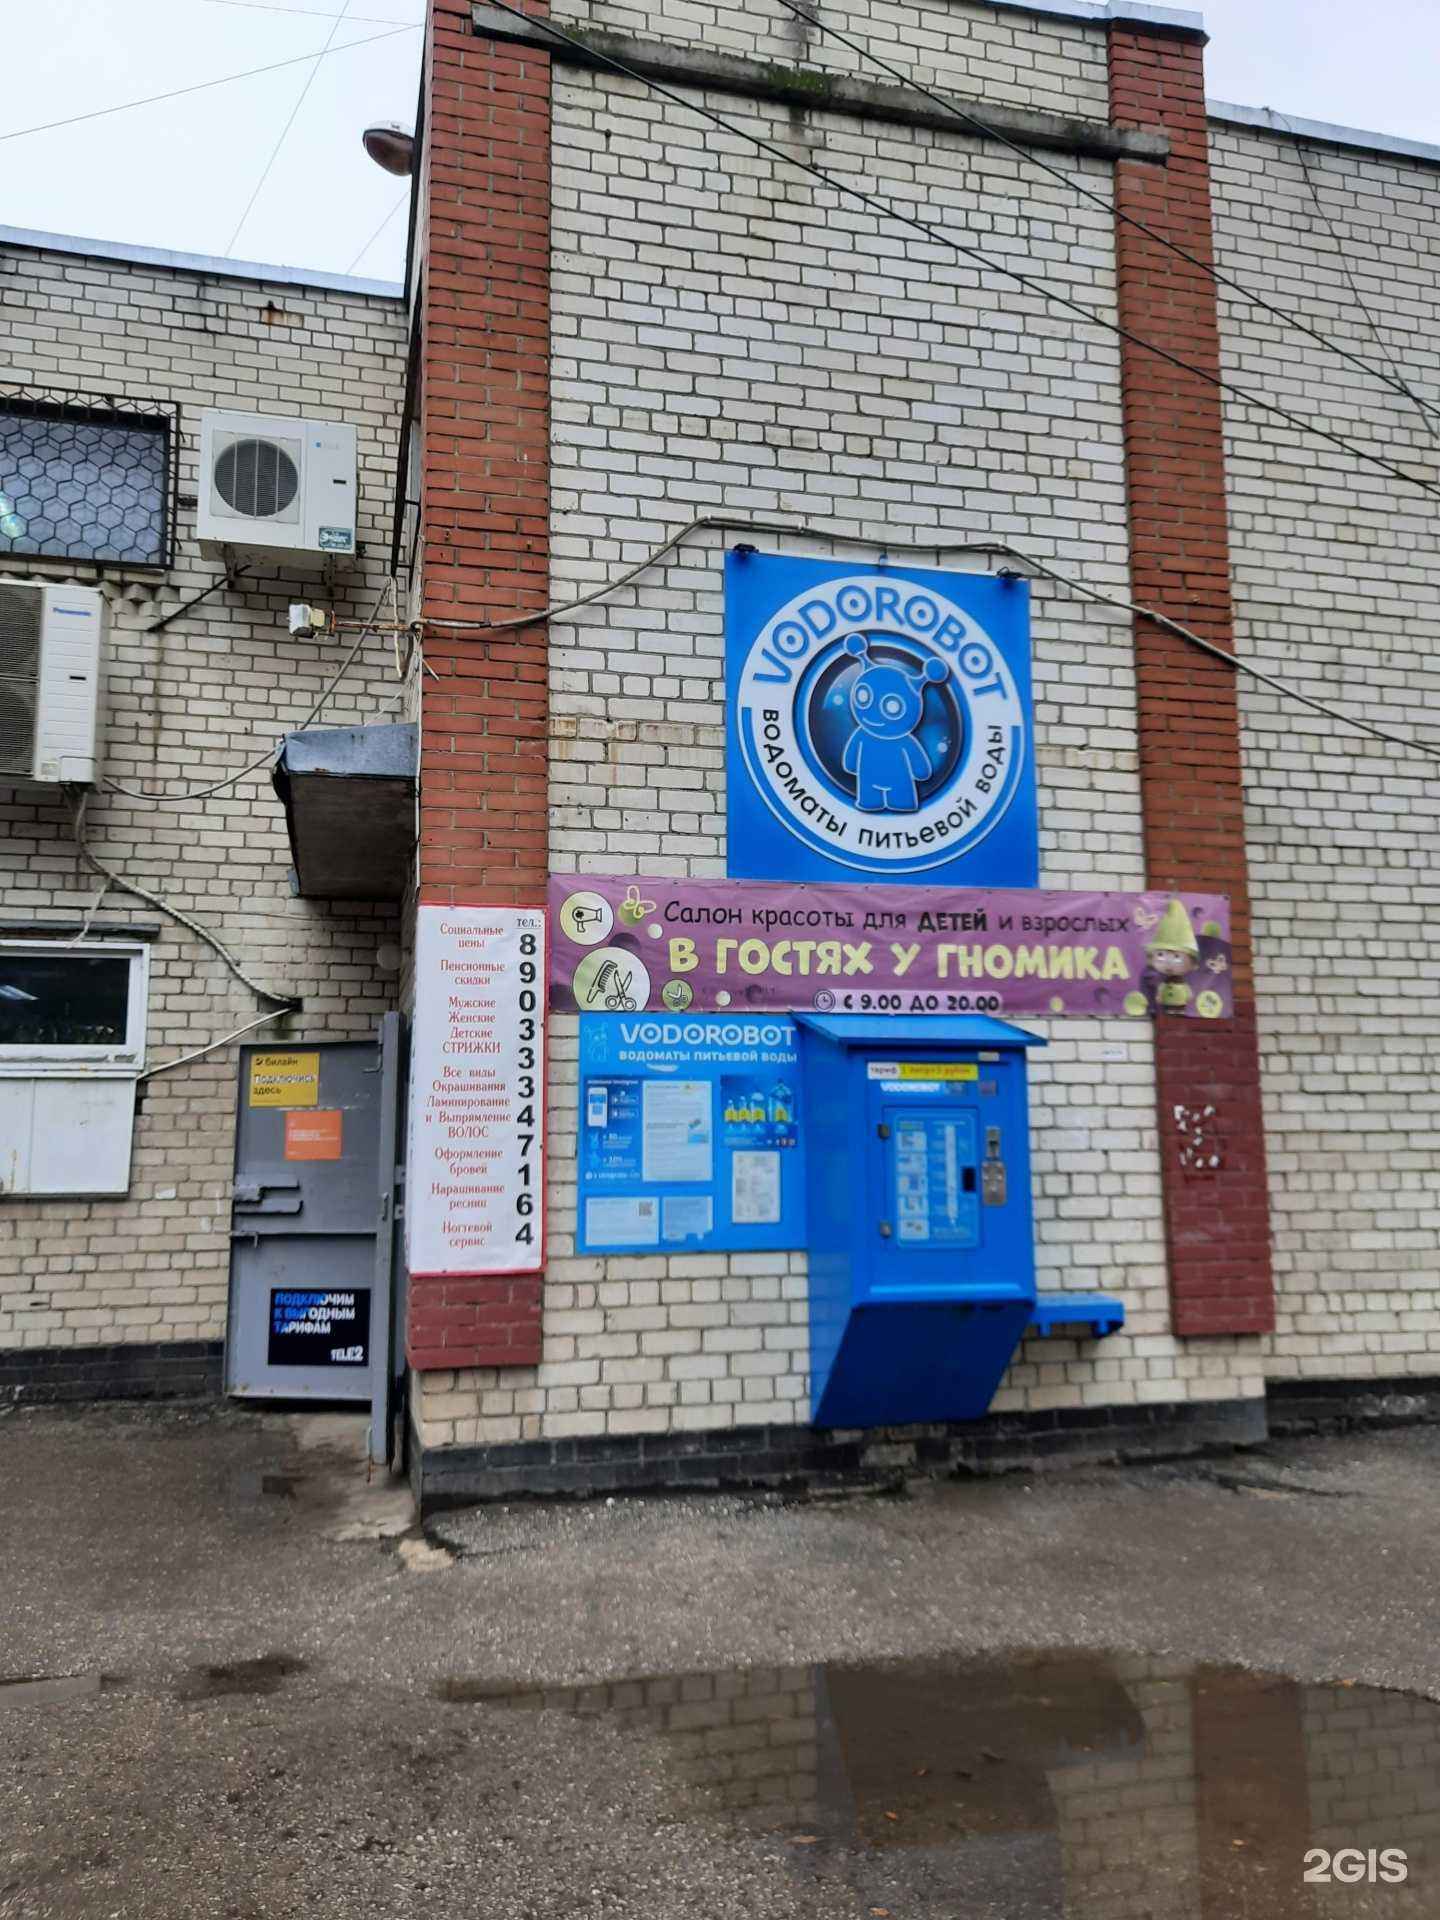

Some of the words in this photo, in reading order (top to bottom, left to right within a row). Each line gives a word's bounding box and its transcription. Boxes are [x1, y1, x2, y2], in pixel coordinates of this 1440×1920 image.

[753, 585, 1006, 700] VODOROBOT
[663, 900, 742, 924] Салон
[752, 908, 854, 931] красоты
[863, 911, 906, 929] для
[917, 907, 988, 933] ДЕТЕЙ
[999, 916, 1013, 930] и
[1022, 917, 1130, 936] взрослых
[440, 921, 504, 936] Социальные
[458, 939, 485, 949] цены
[440, 959, 505, 973] Пенсионные
[668, 937, 699, 973] В
[716, 938, 875, 977] ГОСТЯХ
[890, 942, 921, 976] У
[937, 943, 1131, 981] ГНОМИКА
[454, 976, 490, 986] скидки
[448, 996, 497, 1010] Мужские
[860, 994, 902, 1011] 9.00
[910, 995, 939, 1012] ДО
[946, 996, 999, 1011] 20.00
[448, 1011, 496, 1023] Женские
[450, 1026, 493, 1039] Детские
[619, 1022, 797, 1046] VODOROBOT
[442, 1041, 501, 1054] СТРИЖКИ
[443, 1066, 462, 1078] Все
[469, 1068, 496, 1078] виды
[432, 1080, 506, 1094] Окрашивания
[426, 1096, 511, 1110] Ламинирование
[439, 1111, 512, 1128] Выпрямление
[447, 1126, 490, 1139] ВОЛОС
[434, 1146, 504, 1163] Оформление
[449, 1162, 488, 1177] бровей
[431, 1182, 505, 1197] Наращивание
[442, 1219, 493, 1235] Ногтевой
[449, 1236, 486, 1249] сервис
[274, 1321, 331, 1335] ТАРИФАМ
[330, 1345, 364, 1362] TELE2
